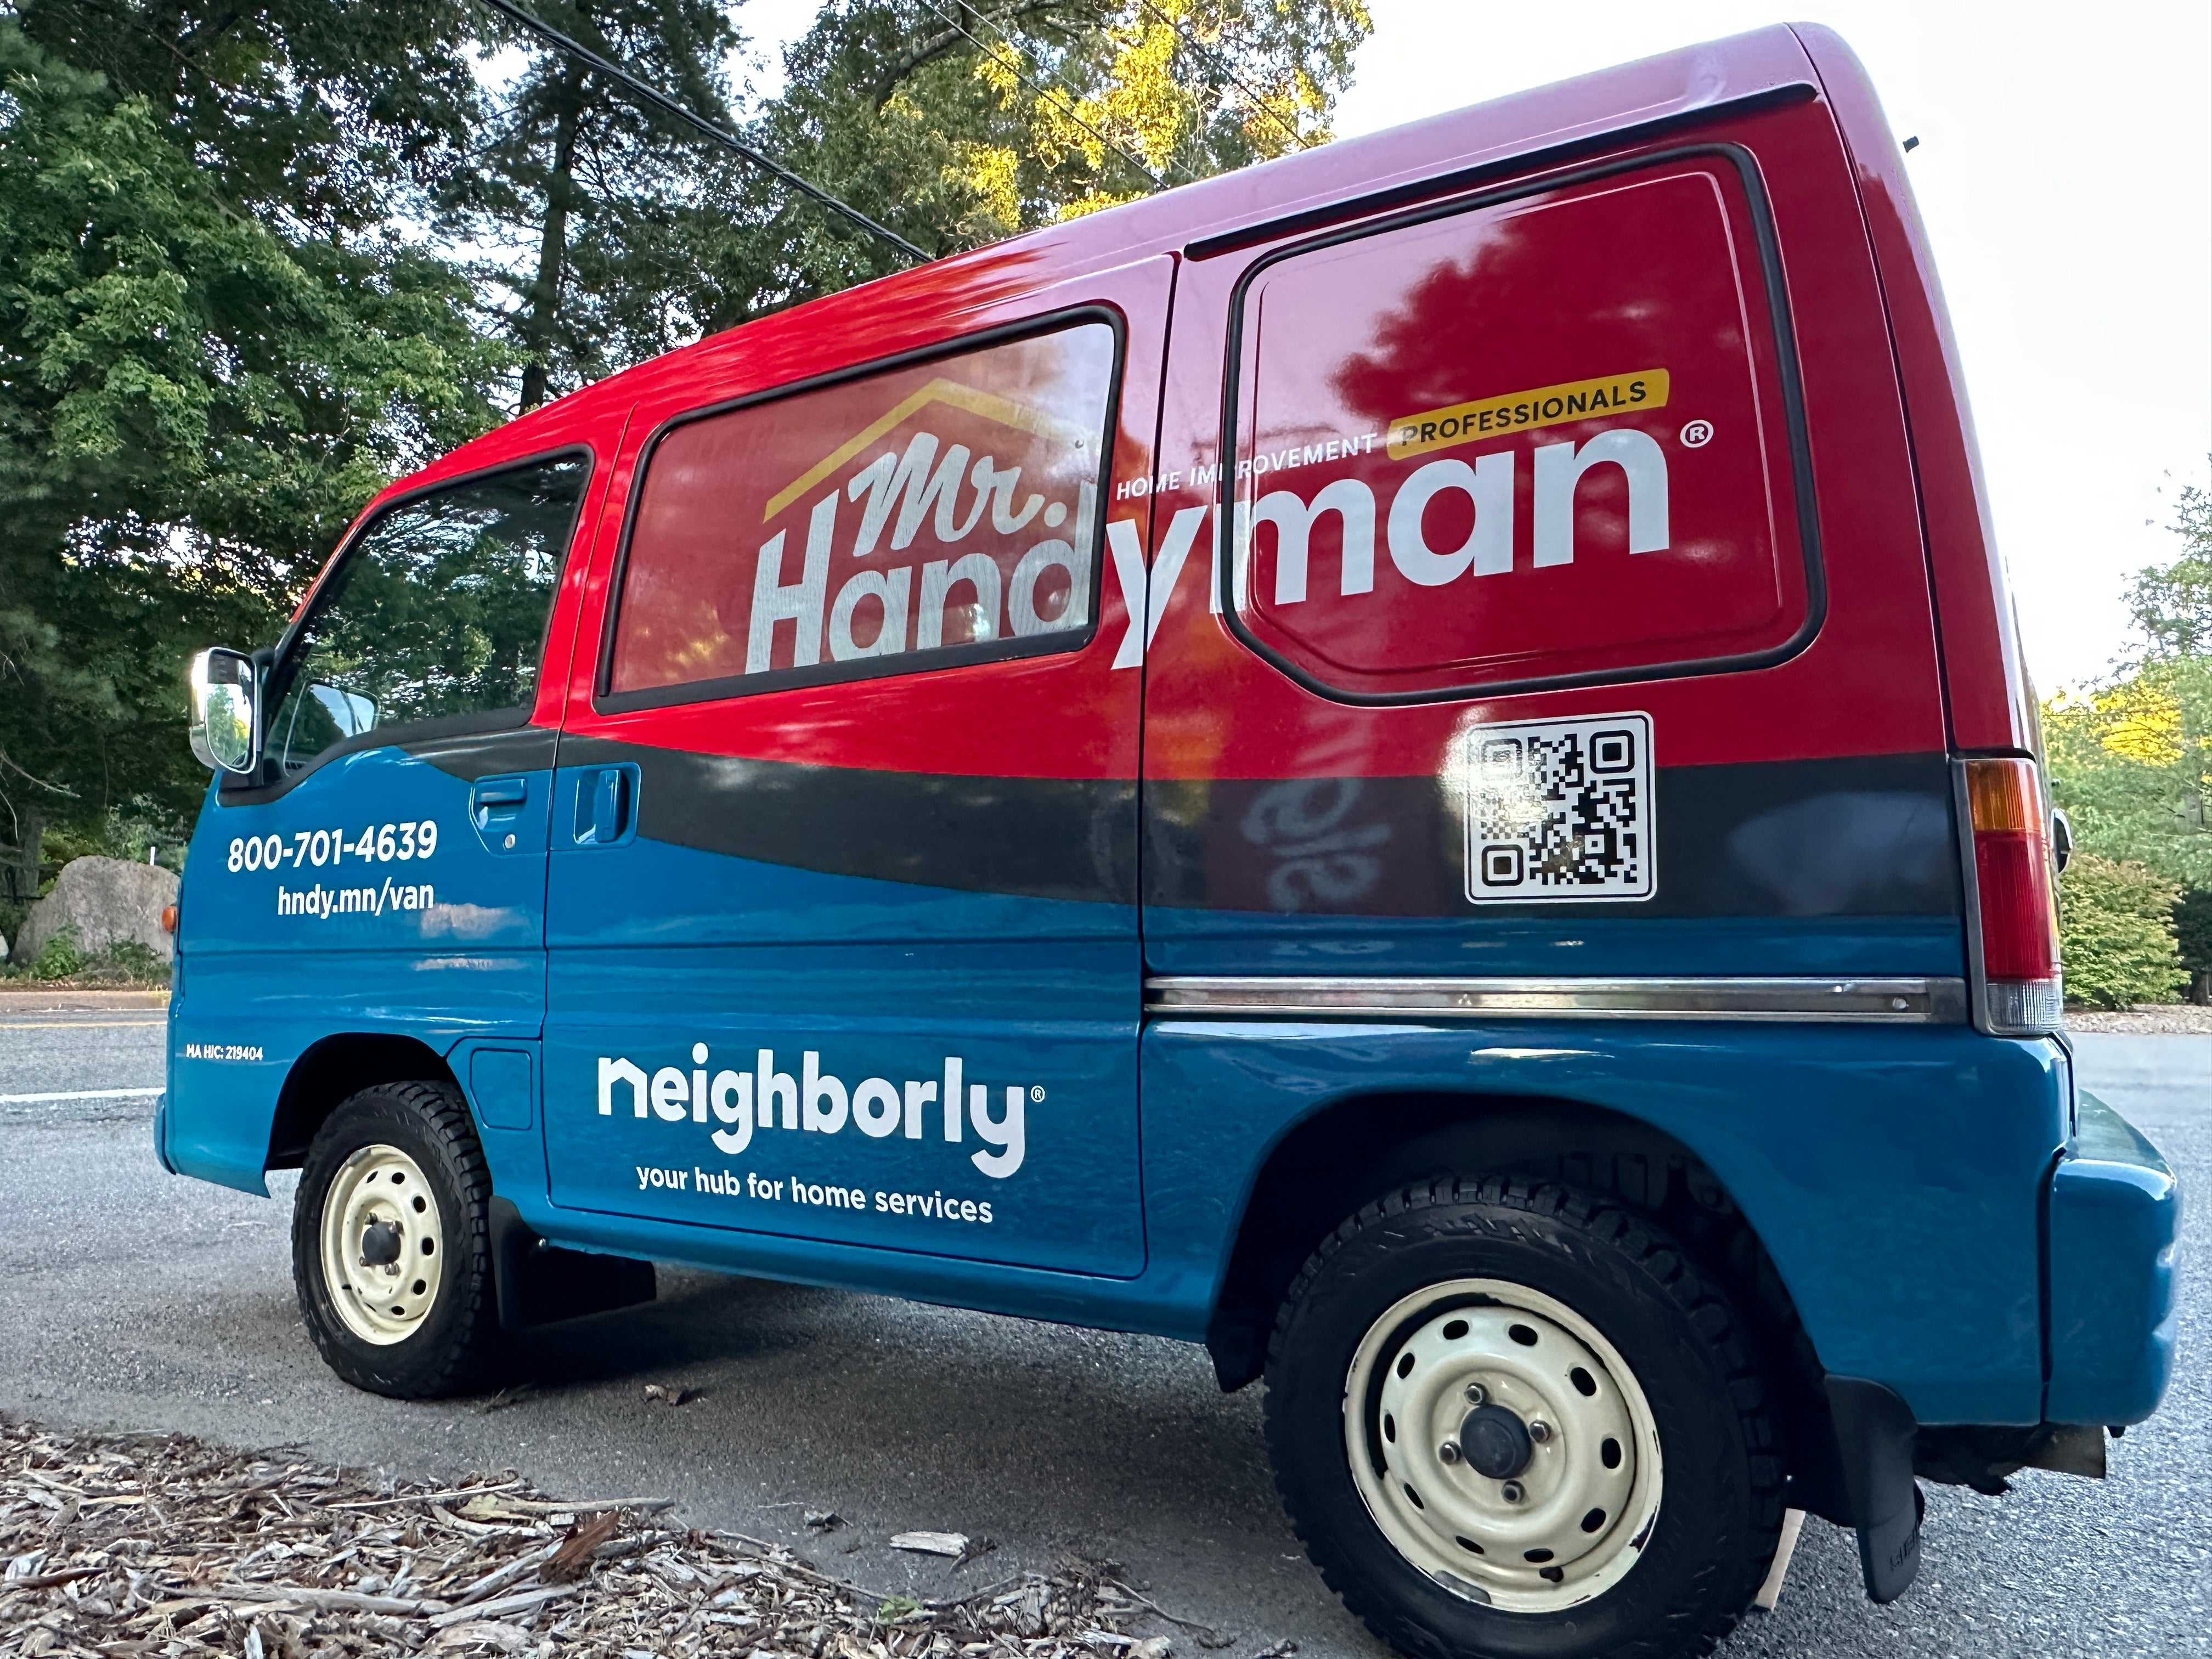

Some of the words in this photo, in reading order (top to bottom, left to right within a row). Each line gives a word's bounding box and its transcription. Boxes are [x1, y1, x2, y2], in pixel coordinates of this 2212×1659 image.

[1116, 471, 1181, 500] HOME
[1189, 432, 1378, 487] IMROVEMENT
[1401, 380, 1647, 446] PROFESSIONALS
[847, 431, 1068, 557] Mr.
[228, 820, 438, 872] 800-701-4639
[278, 877, 434, 919] hndy.mn/van
[203, 1045, 224, 1059] HIC:
[225, 1045, 263, 1061] 219404
[636, 1165, 688, 1190] your
[695, 1166, 741, 1196] hub
[747, 1172, 783, 1201] for
[791, 1176, 867, 1210] home
[874, 1191, 994, 1224] services
